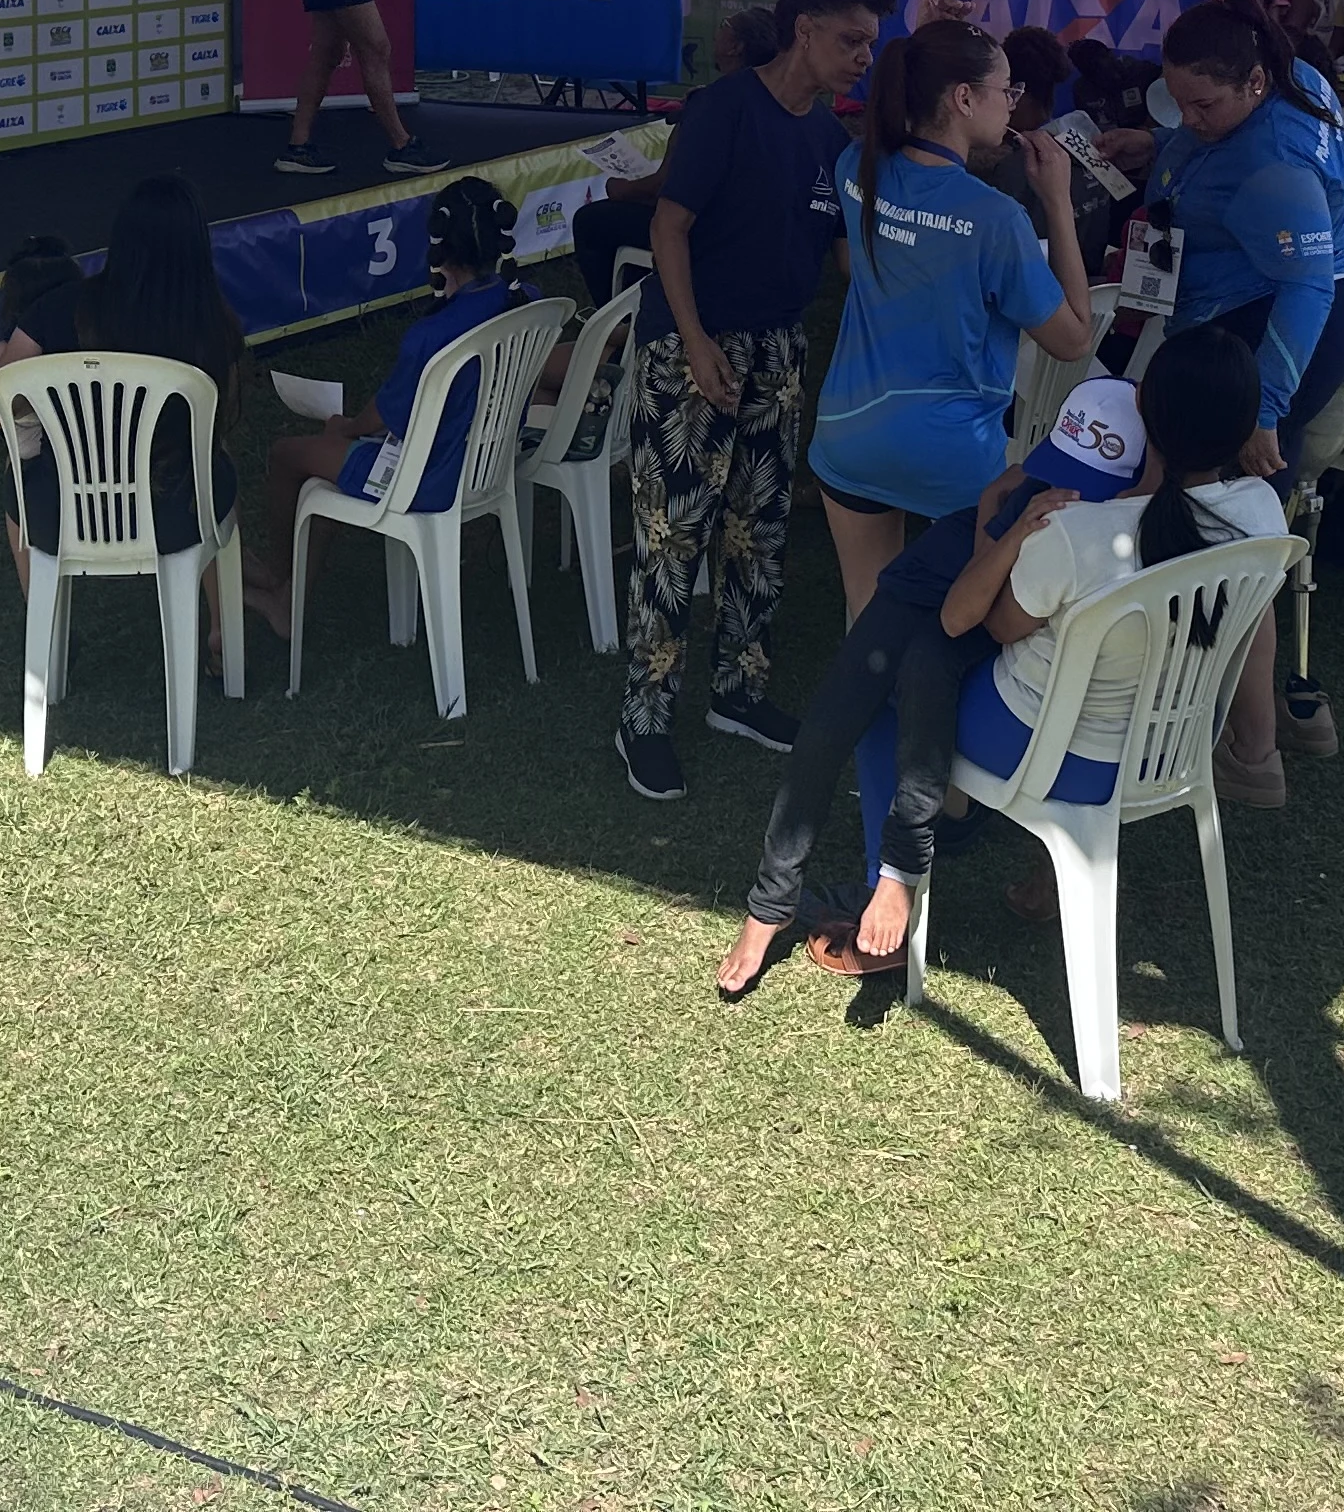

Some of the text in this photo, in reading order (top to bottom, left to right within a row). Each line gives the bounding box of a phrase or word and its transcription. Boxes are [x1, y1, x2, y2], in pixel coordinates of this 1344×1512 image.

[96, 24, 126, 36] CAIXA
[536, 200, 563, 217] CBCa
[878, 222, 918, 246] IASMIN
[916, 210, 974, 236] ITAJAÍ-SC
[367, 217, 398, 276] 3
